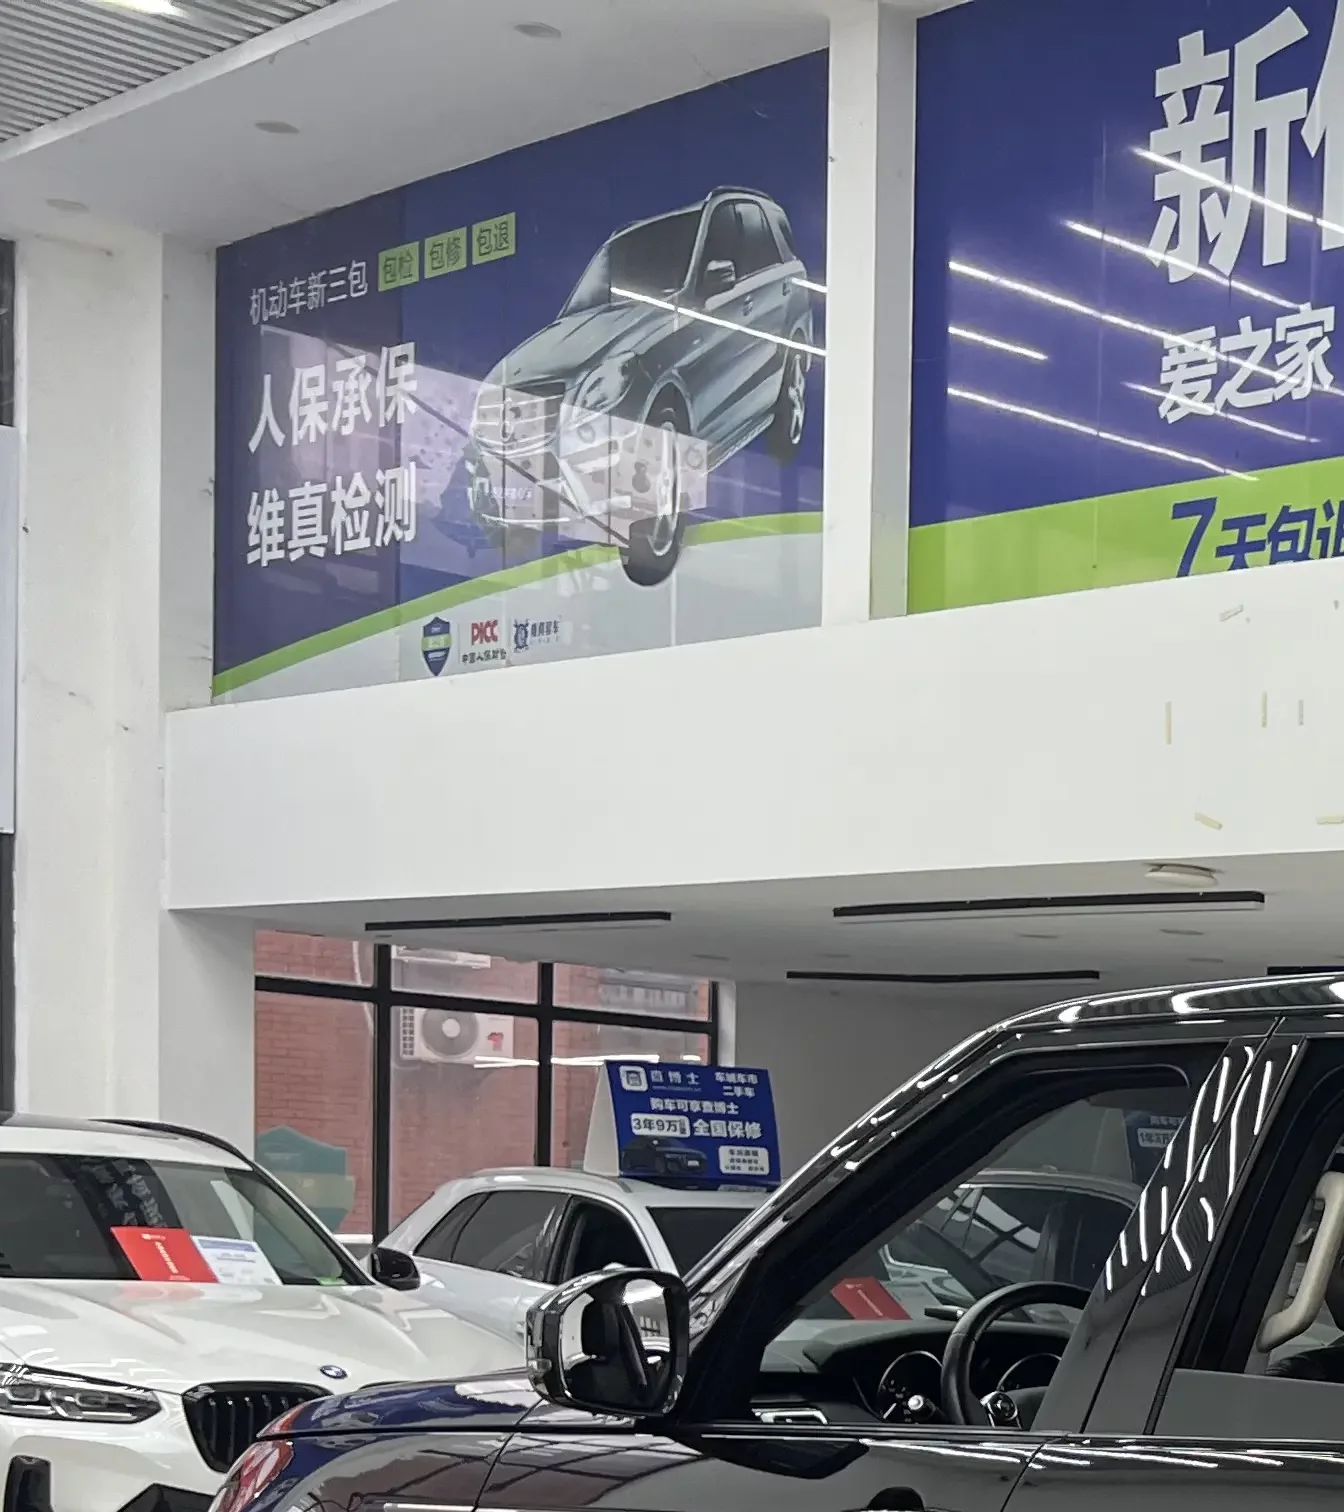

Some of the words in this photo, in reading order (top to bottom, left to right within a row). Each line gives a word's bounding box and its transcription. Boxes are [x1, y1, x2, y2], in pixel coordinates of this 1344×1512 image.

[249, 259, 368, 326] 机动车新三包
[428, 236, 461, 271] 包修
[476, 220, 510, 257] 包退
[249, 342, 420, 454] 人保承保
[1158, 302, 1335, 424] 爱之家
[246, 461, 417, 567] 维真检测
[471, 619, 498, 645] PICC
[693, 1118, 762, 1139] 全国保修
